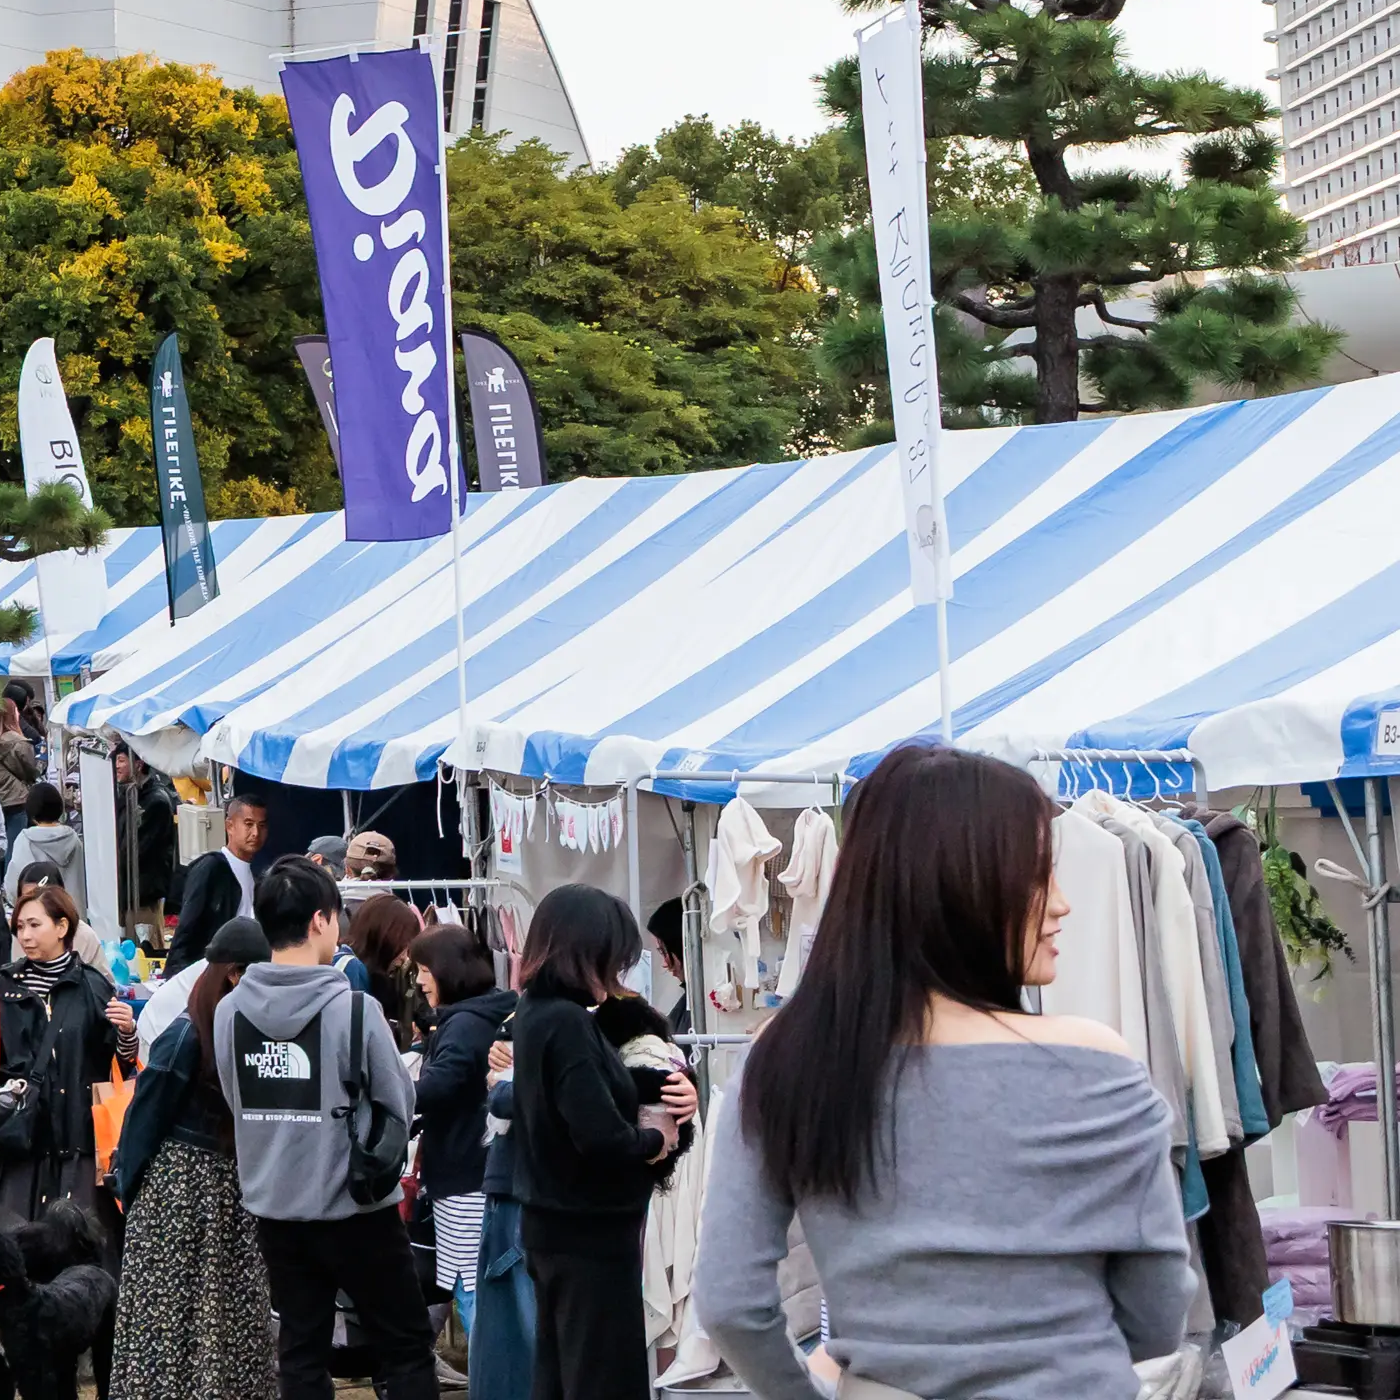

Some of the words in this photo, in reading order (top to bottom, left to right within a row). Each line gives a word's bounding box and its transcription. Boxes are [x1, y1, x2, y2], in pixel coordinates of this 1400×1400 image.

[262, 1041, 288, 1054] THE
[244, 1053, 288, 1067] NORTH
[258, 1065, 289, 1078] FACE
